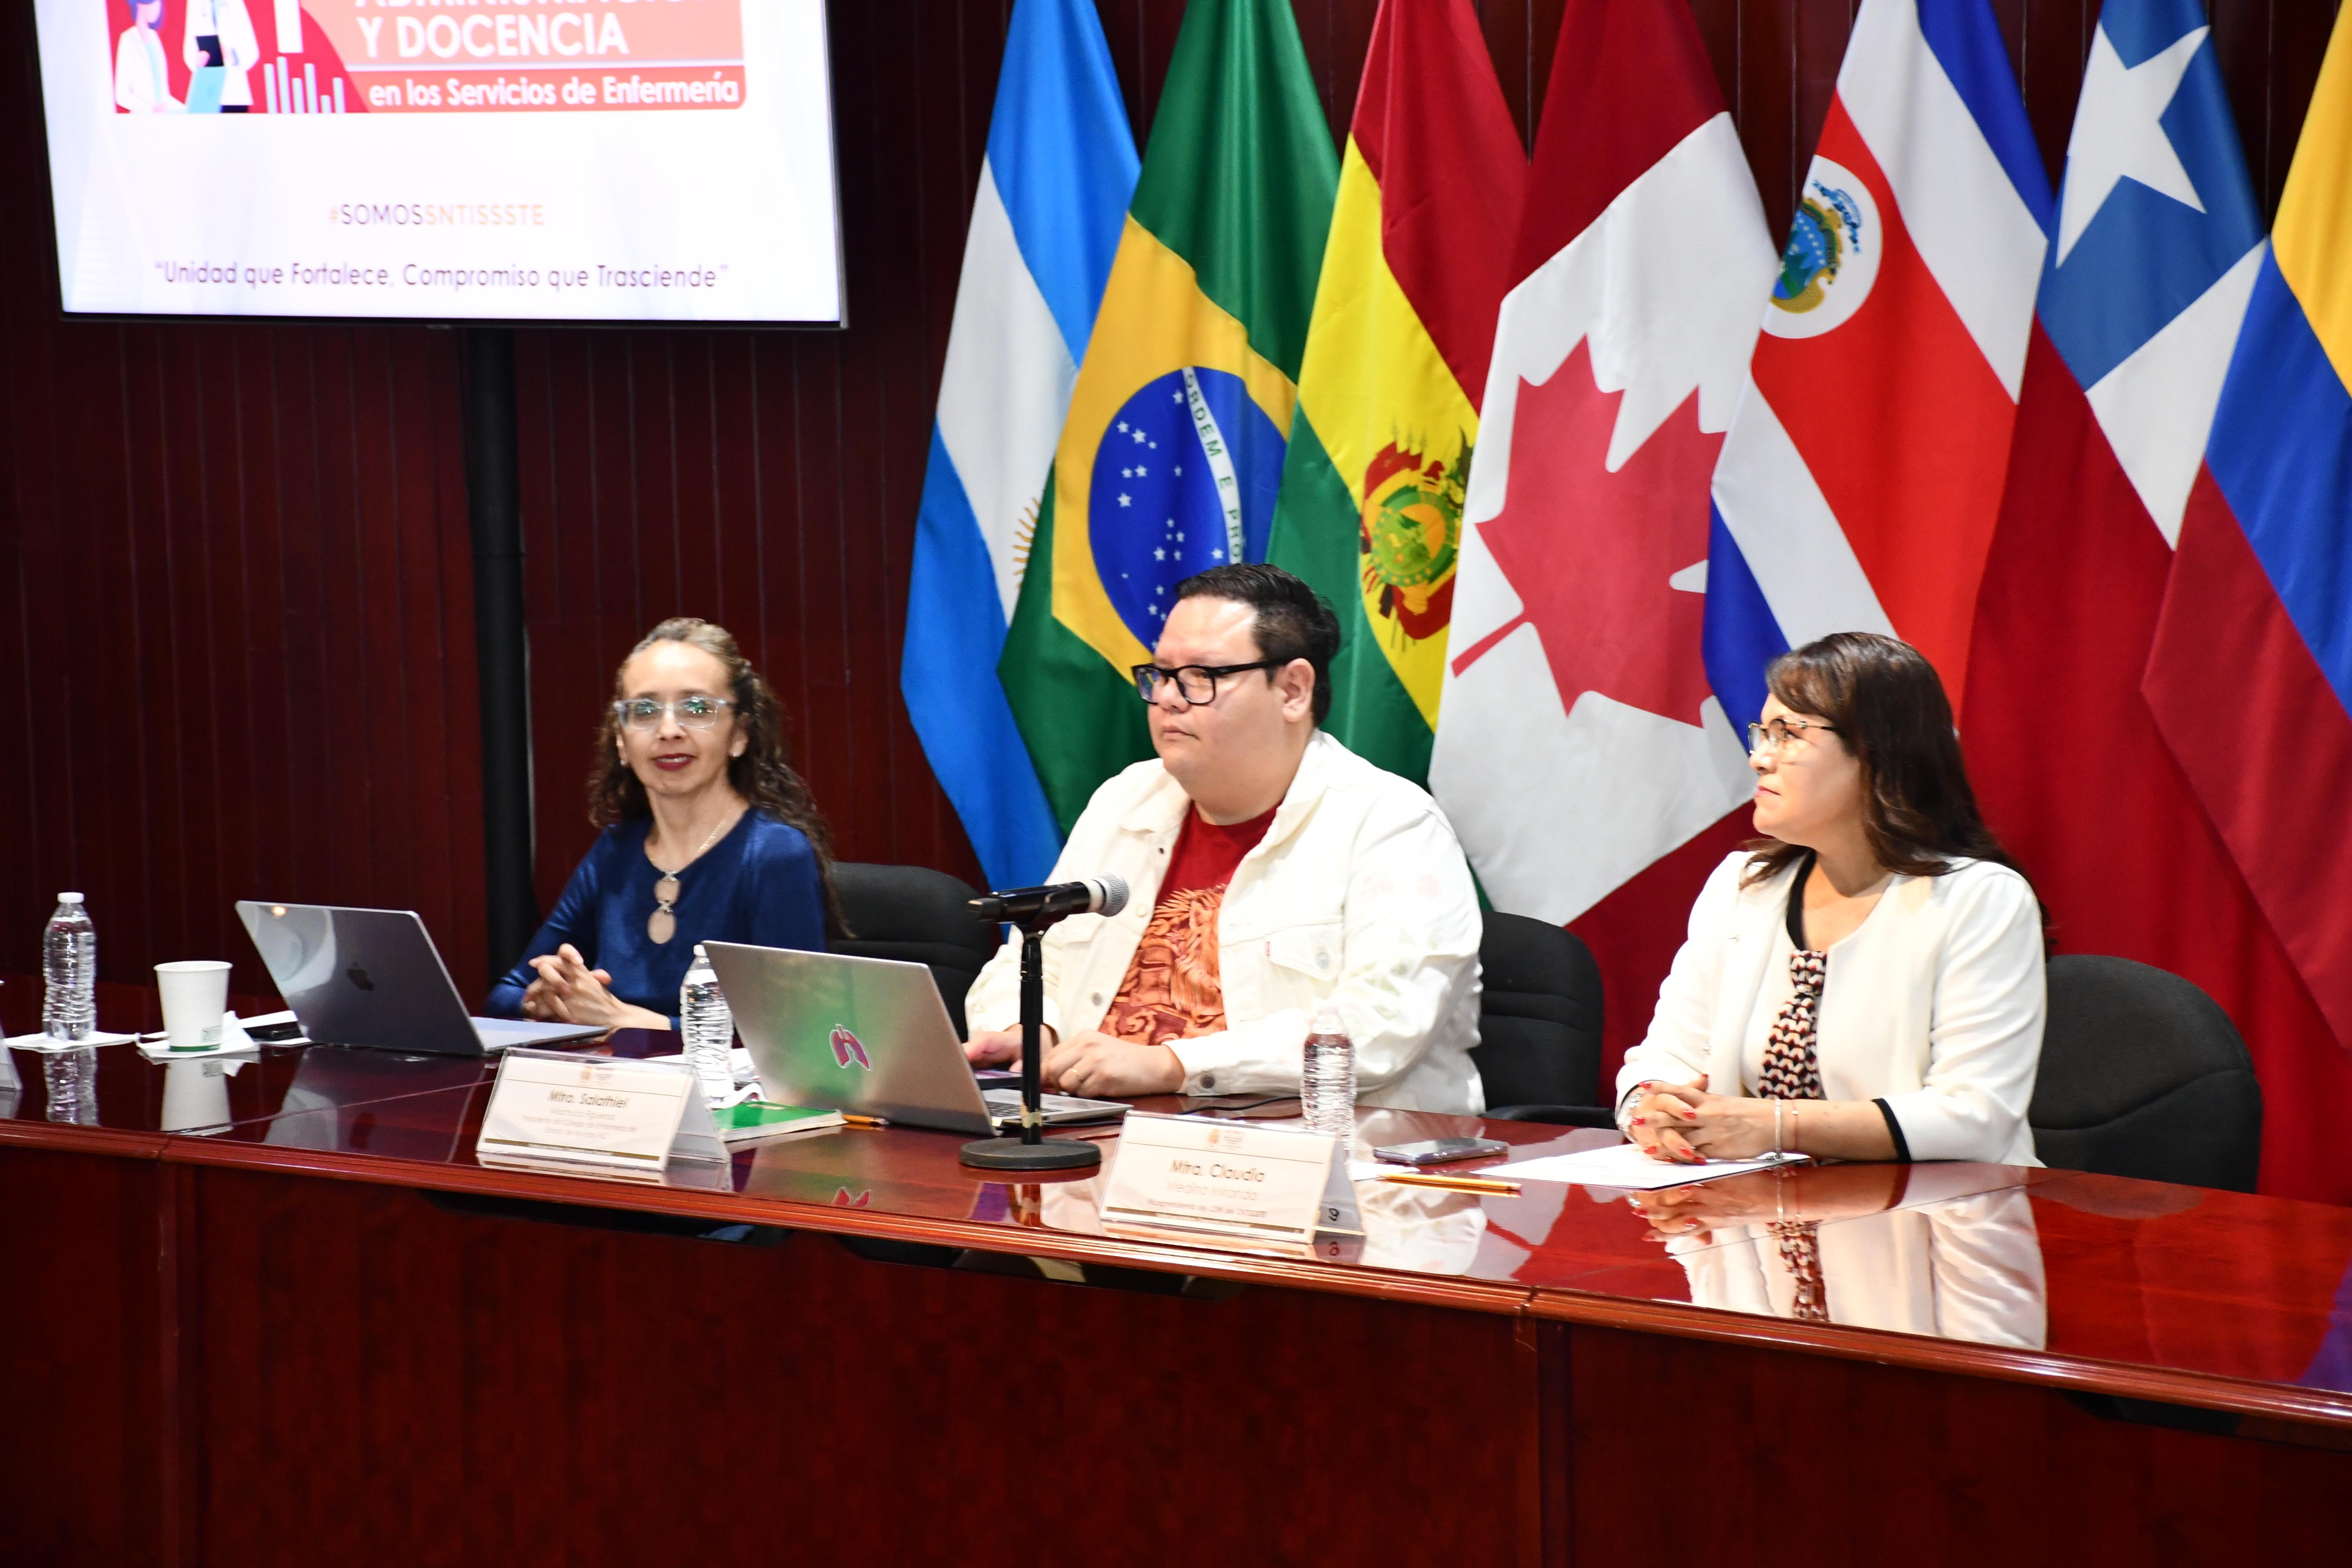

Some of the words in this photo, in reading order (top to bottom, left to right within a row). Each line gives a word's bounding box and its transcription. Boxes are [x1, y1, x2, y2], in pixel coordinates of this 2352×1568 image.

[357, 16, 383, 57] Y
[396, 13, 630, 57] DOCENCIA
[370, 84, 401, 106] en
[406, 79, 441, 106] los
[446, 77, 557, 106] Servicios
[562, 76, 596, 104] de
[603, 72, 738, 104] Enfermería
[245, 267, 283, 290] que
[403, 264, 539, 292] Compromiso
[548, 269, 589, 292] que
[1169, 1160, 1204, 1176] Mtra.
[1210, 1164, 1266, 1182] Claudia
